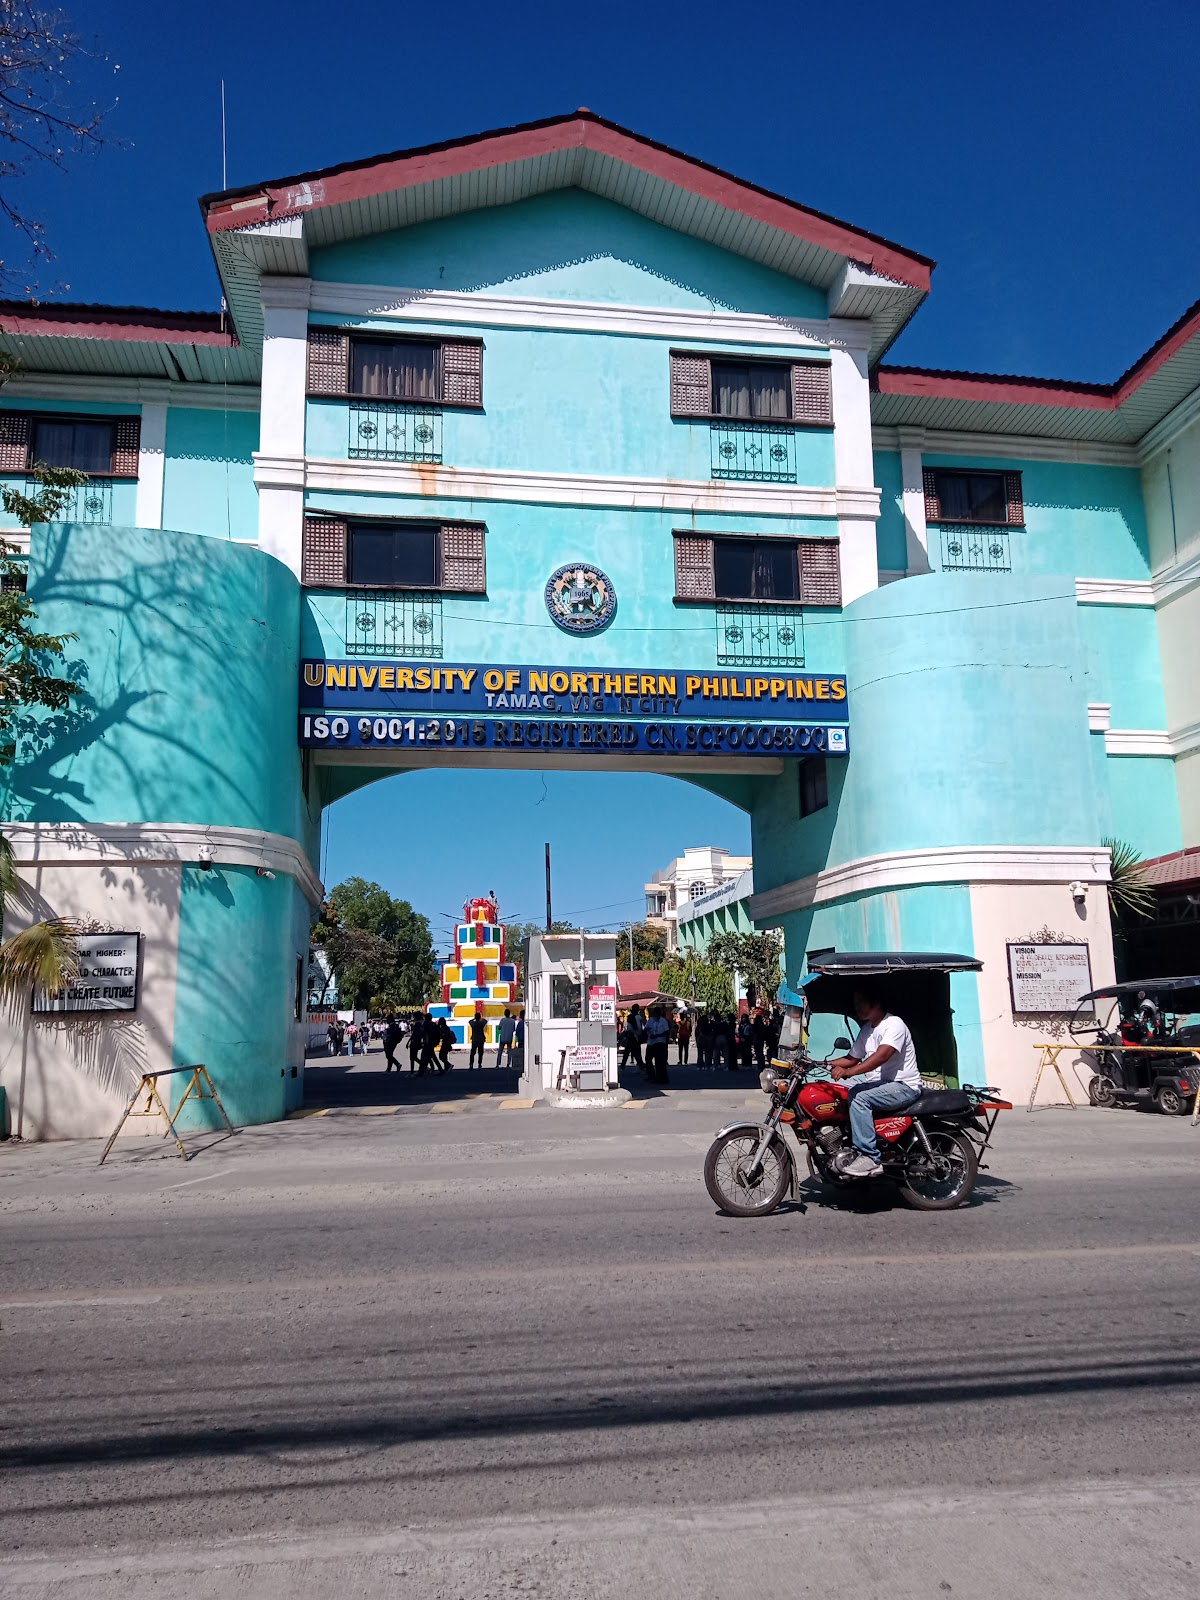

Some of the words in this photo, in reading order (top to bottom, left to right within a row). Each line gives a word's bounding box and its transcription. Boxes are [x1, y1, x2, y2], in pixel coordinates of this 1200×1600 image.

[575, 590, 589, 598] 1965
[304, 663, 477, 690] UNIVERSITY
[483, 669, 522, 692] OF
[528, 671, 677, 696] NORTHERN
[685, 675, 846, 700] PHILIPPINES
[485, 693, 562, 712] TAMAG,
[639, 697, 682, 715] CITY
[304, 717, 349, 739] ISO
[357, 718, 486, 742] 9001:2015
[492, 721, 638, 746] REGISTERED
[67, 988, 100, 1000] CREATE
[103, 986, 134, 998] FUTURE
[884, 1130, 901, 1138] YAMAHA
